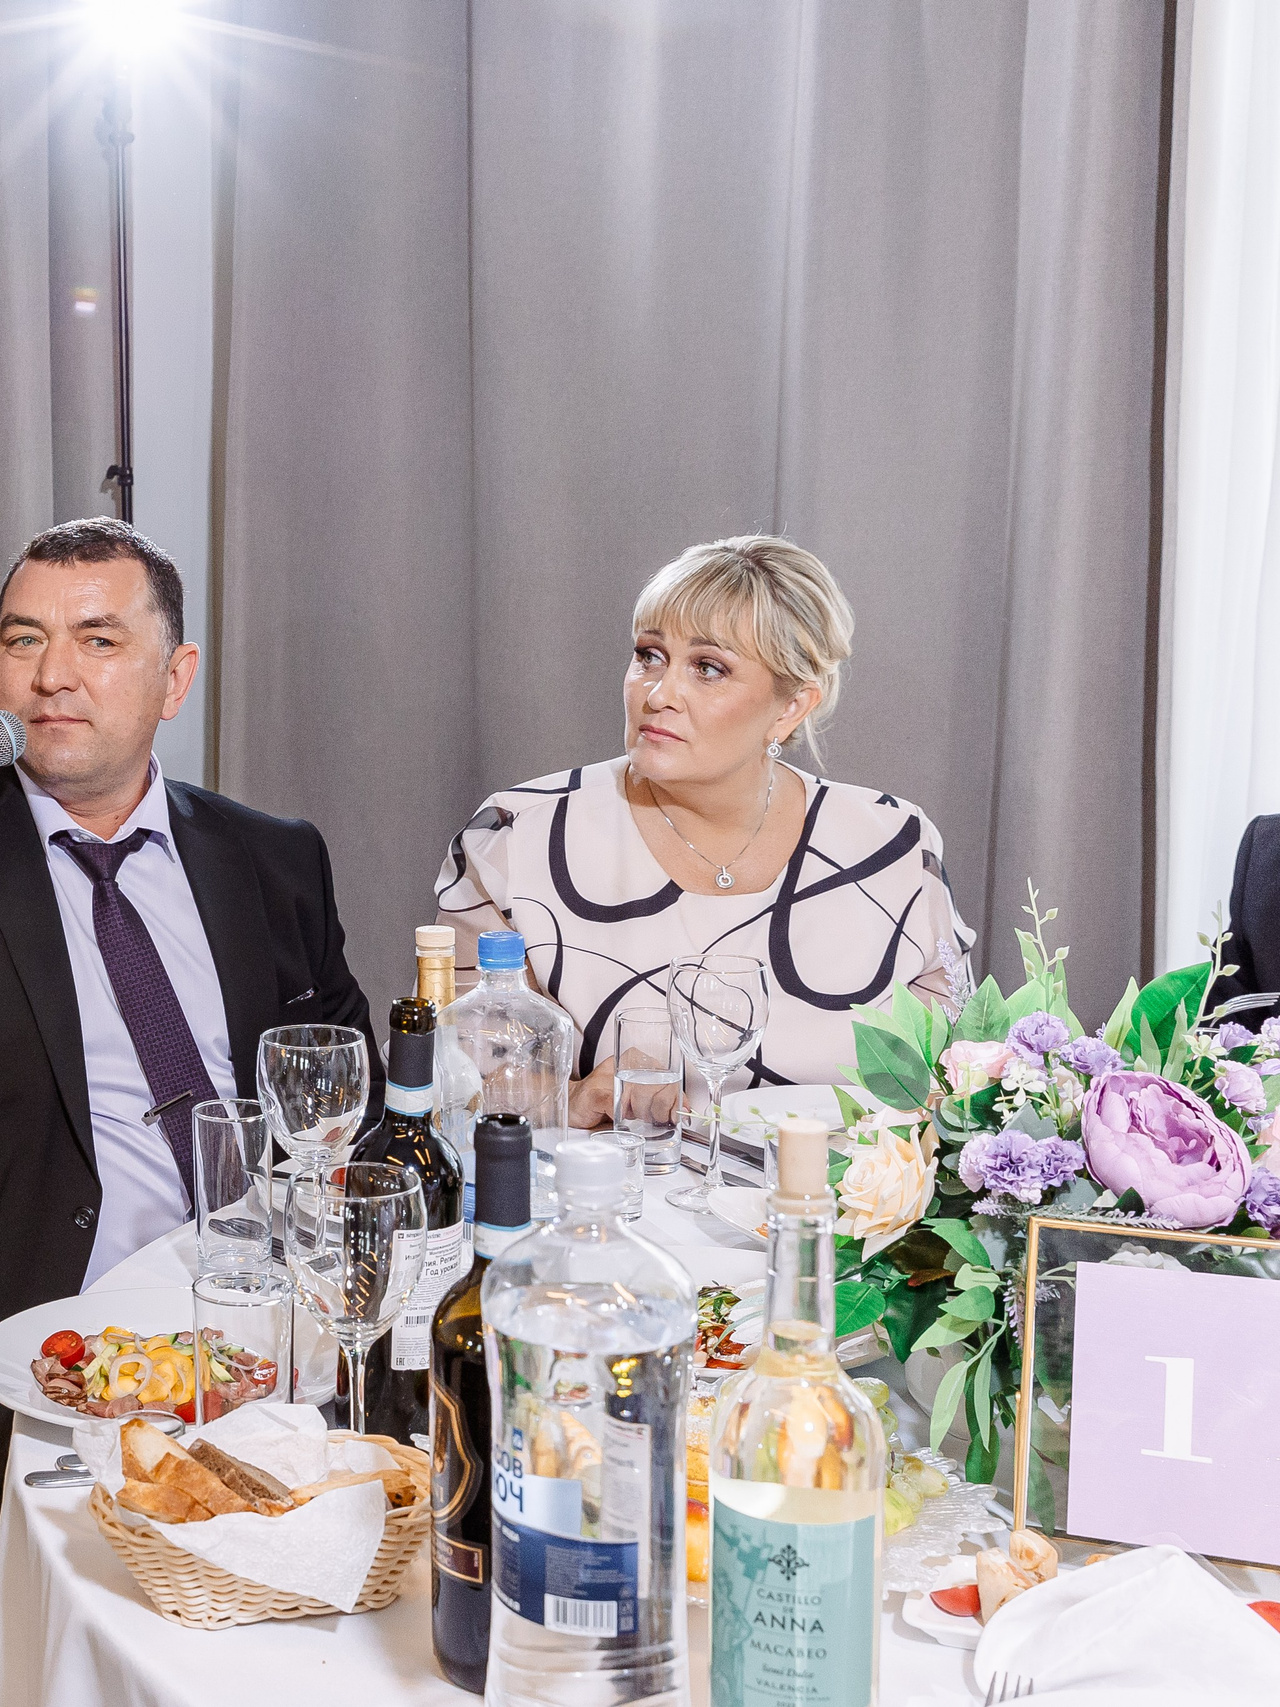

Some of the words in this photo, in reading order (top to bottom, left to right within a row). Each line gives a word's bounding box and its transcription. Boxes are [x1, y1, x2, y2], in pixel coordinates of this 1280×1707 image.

[425, 1268, 439, 1276] Год
[1140, 1355, 1213, 1464] 1
[757, 1588, 822, 1606] CASTILLO
[753, 1611, 824, 1633] ANNA
[750, 1639, 827, 1660] MACABEO
